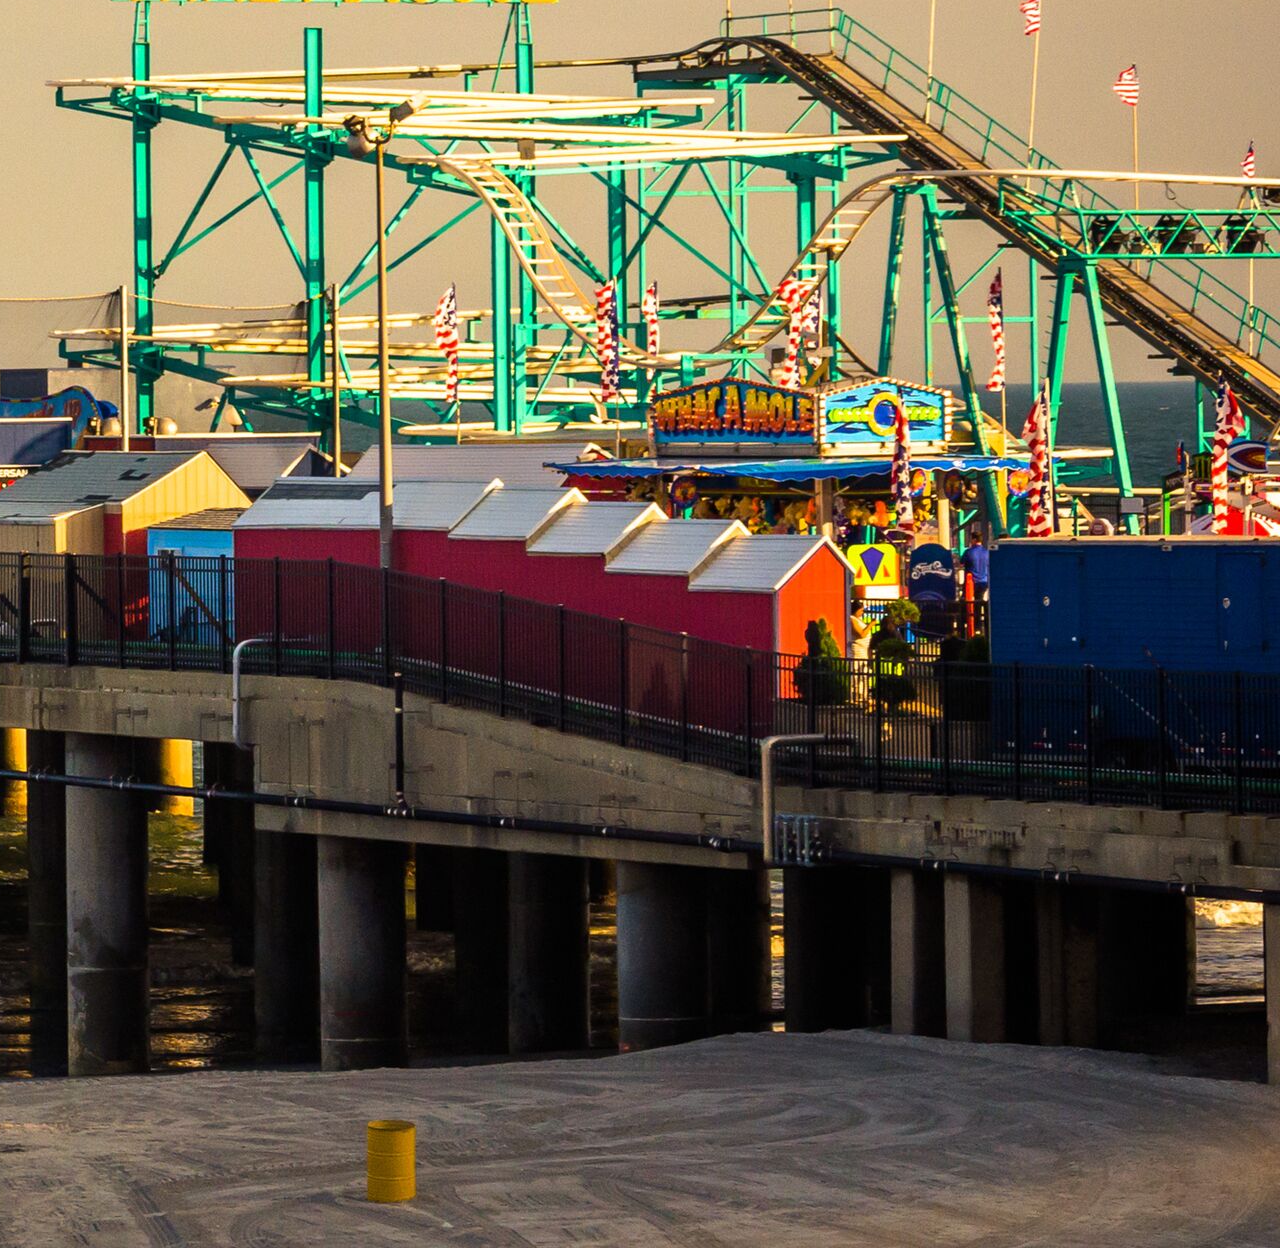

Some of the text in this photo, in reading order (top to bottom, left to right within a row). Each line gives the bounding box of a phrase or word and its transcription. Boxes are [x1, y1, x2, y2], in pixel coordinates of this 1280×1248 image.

[655, 384, 814, 432] WHAC A MOLE
